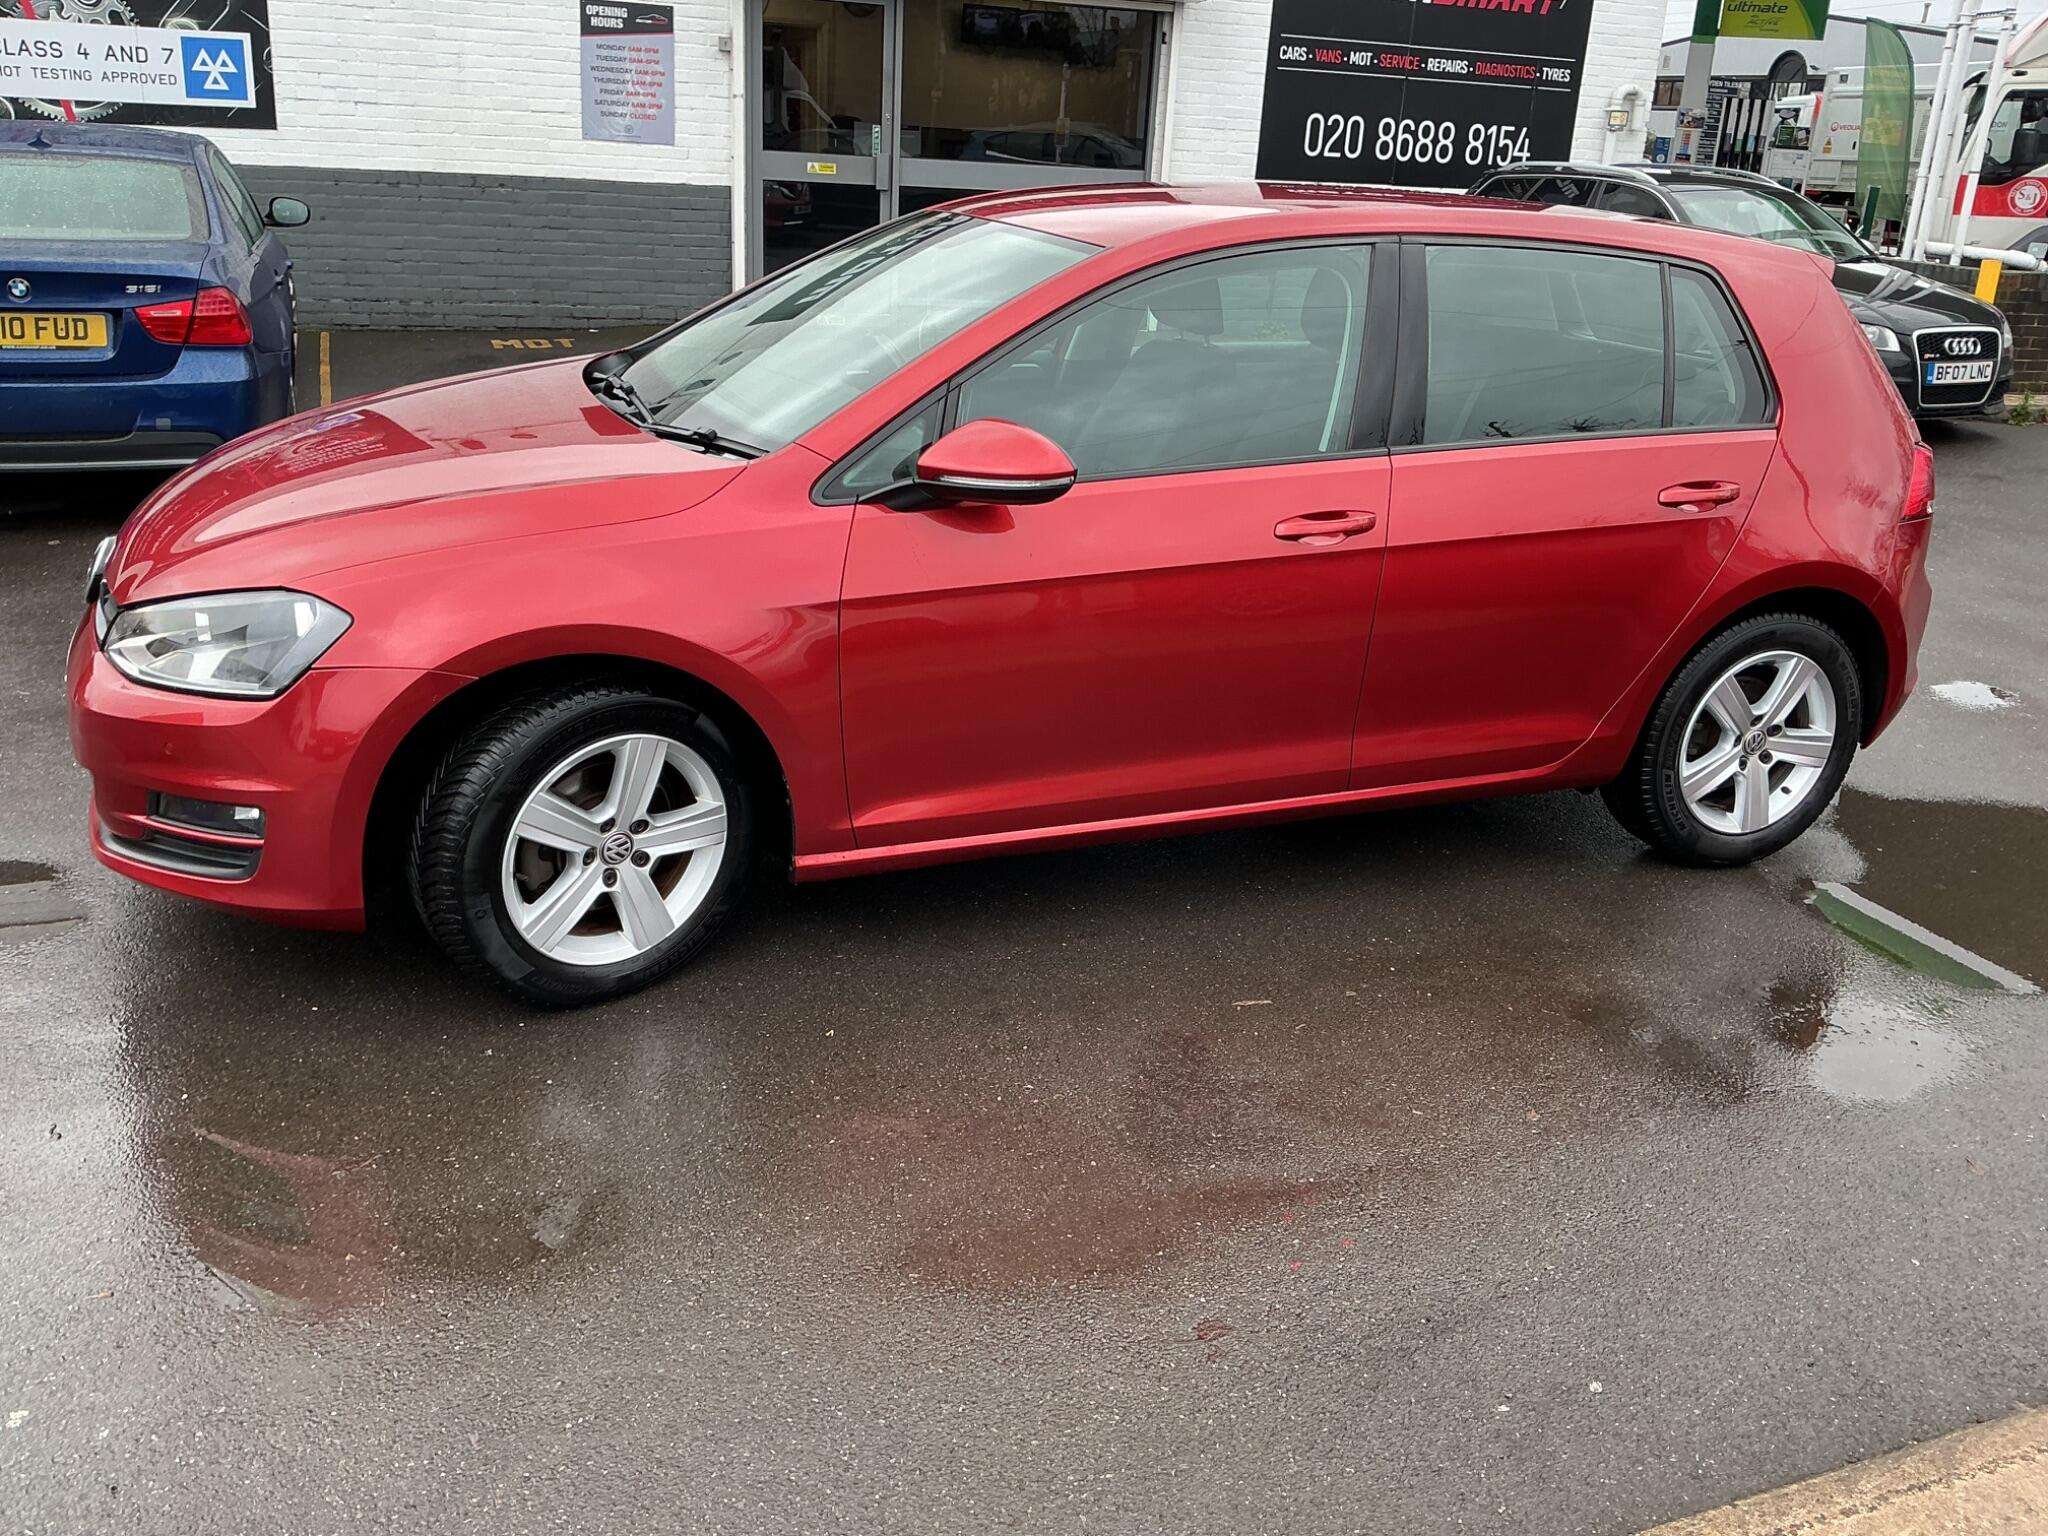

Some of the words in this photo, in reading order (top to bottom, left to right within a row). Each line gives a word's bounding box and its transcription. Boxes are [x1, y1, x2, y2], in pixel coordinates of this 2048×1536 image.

[586, 5, 628, 17] OPENING
[1727, 2, 1788, 13] ultimate
[591, 16, 624, 28] HOURS
[0, 38, 63, 58] LASS
[77, 42, 90, 60] 4
[105, 44, 149, 63] AND
[161, 47, 174, 64] 7
[596, 43, 626, 51] MONDAY
[595, 54, 627, 63] TUESDAY
[1280, 45, 1307, 61] CARS
[1315, 48, 1342, 64] VANS
[1349, 51, 1373, 66] MOT
[1380, 53, 1420, 70] SERVICE
[1427, 58, 1468, 74] REPAIRS
[1475, 62, 1536, 79] DIAGNOSTICS
[1542, 67, 1571, 82] TYRES
[590, 65, 633, 74] WEDNESDAY
[30, 66, 93, 81] TESTING
[101, 71, 178, 85] APPROVED
[593, 76, 630, 85] THURSDAY
[599, 88, 624, 96] FRIDAY
[594, 98, 630, 107] SATURDAY
[600, 110, 627, 119] SUNDAY
[629, 113, 657, 121] CLOSED
[1303, 113, 1365, 159] 020
[1375, 117, 1456, 164] 8688
[1465, 123, 1531, 168] 8154
[34, 316, 89, 341] FUD
[490, 338, 575, 349] MOT
[1936, 365, 1967, 380] BF07
[1970, 364, 1991, 379] LNC
